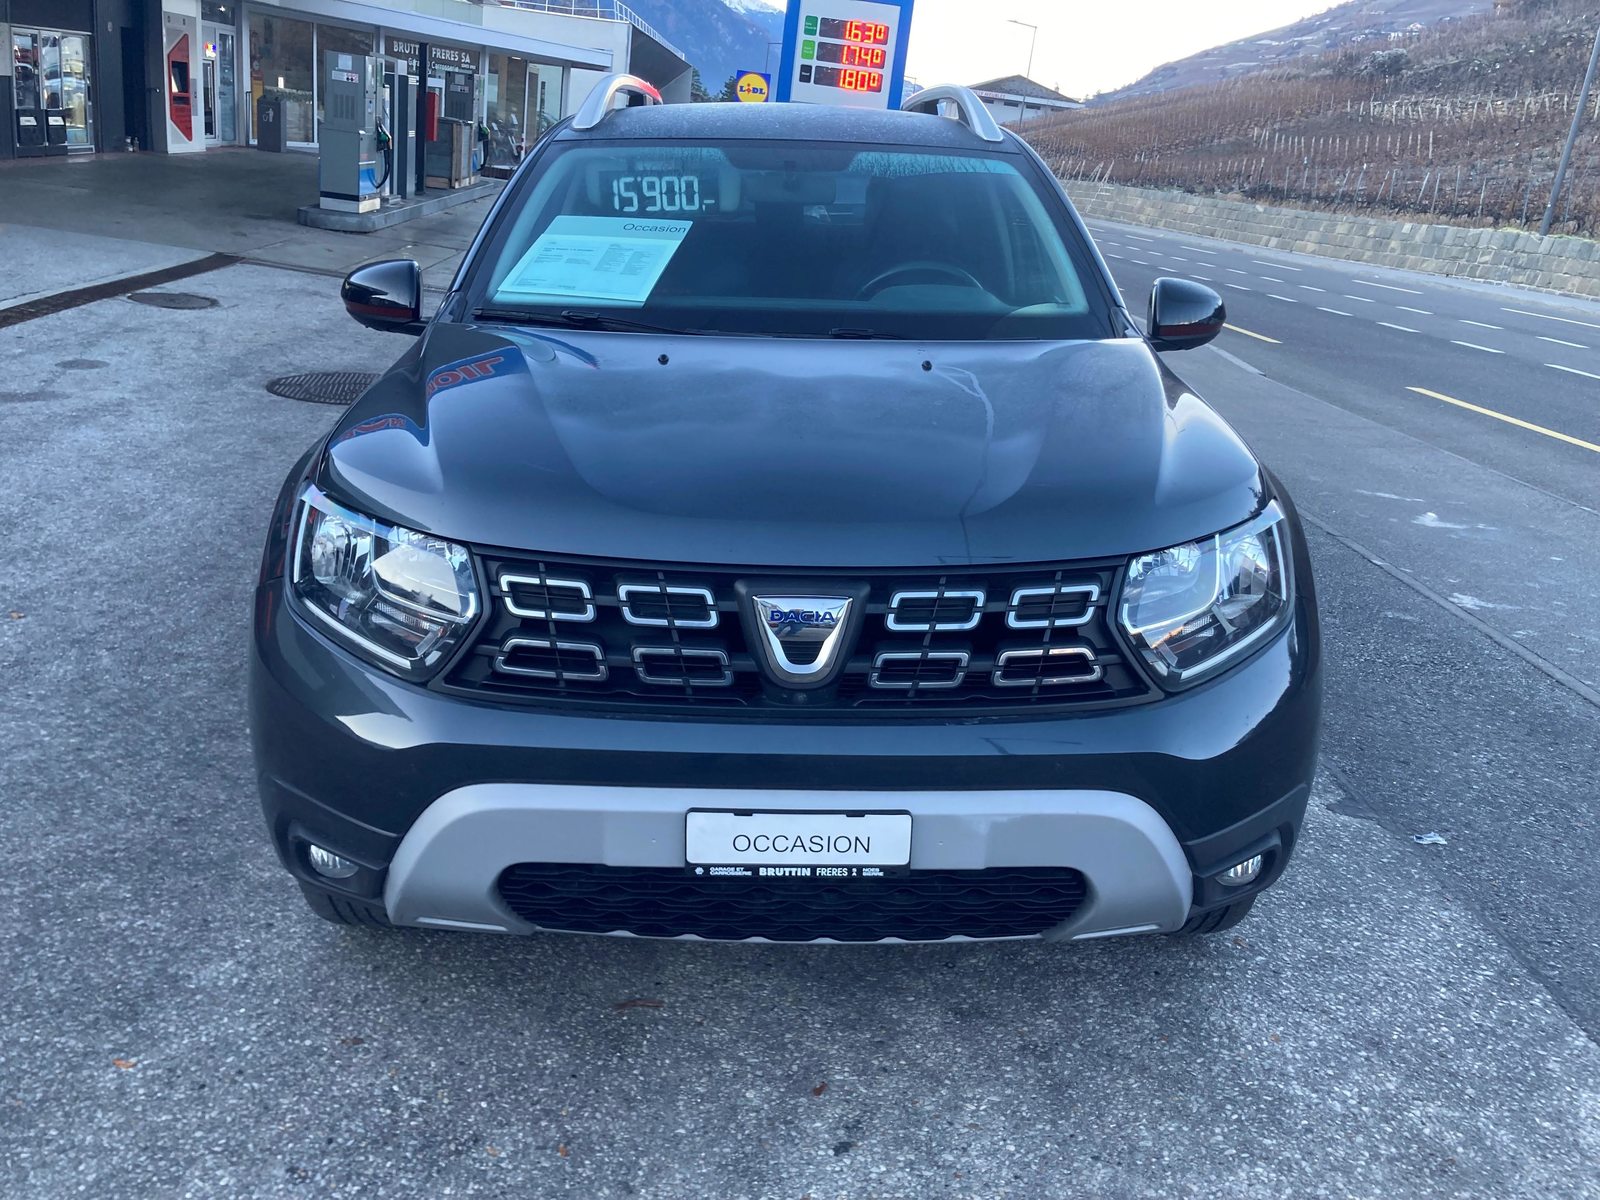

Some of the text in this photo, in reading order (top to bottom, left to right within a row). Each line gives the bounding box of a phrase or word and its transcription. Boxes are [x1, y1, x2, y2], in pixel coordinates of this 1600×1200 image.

[393, 40, 420, 55] BRUTT
[461, 51, 471, 64] SA
[623, 223, 687, 234] Occasion
[769, 610, 836, 623] DACIA
[732, 834, 871, 854] OCCASION
[759, 867, 811, 877] BRUTTIN
